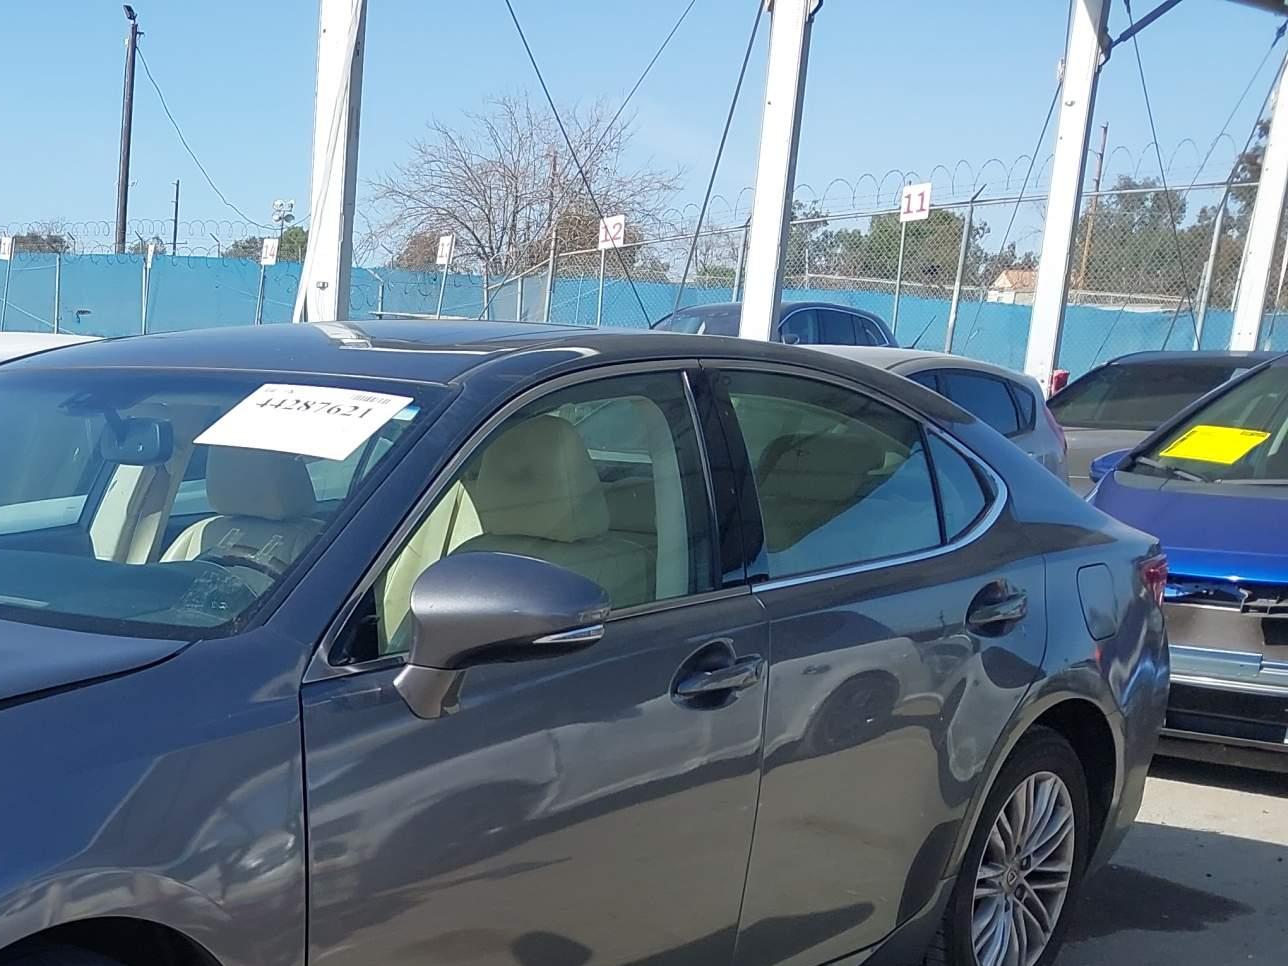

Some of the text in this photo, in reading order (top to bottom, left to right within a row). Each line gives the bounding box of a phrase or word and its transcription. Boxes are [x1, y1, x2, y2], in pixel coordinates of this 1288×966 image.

[902, 191, 927, 214] 11
[600, 222, 623, 243] 12
[256, 397, 373, 419] 44287621
